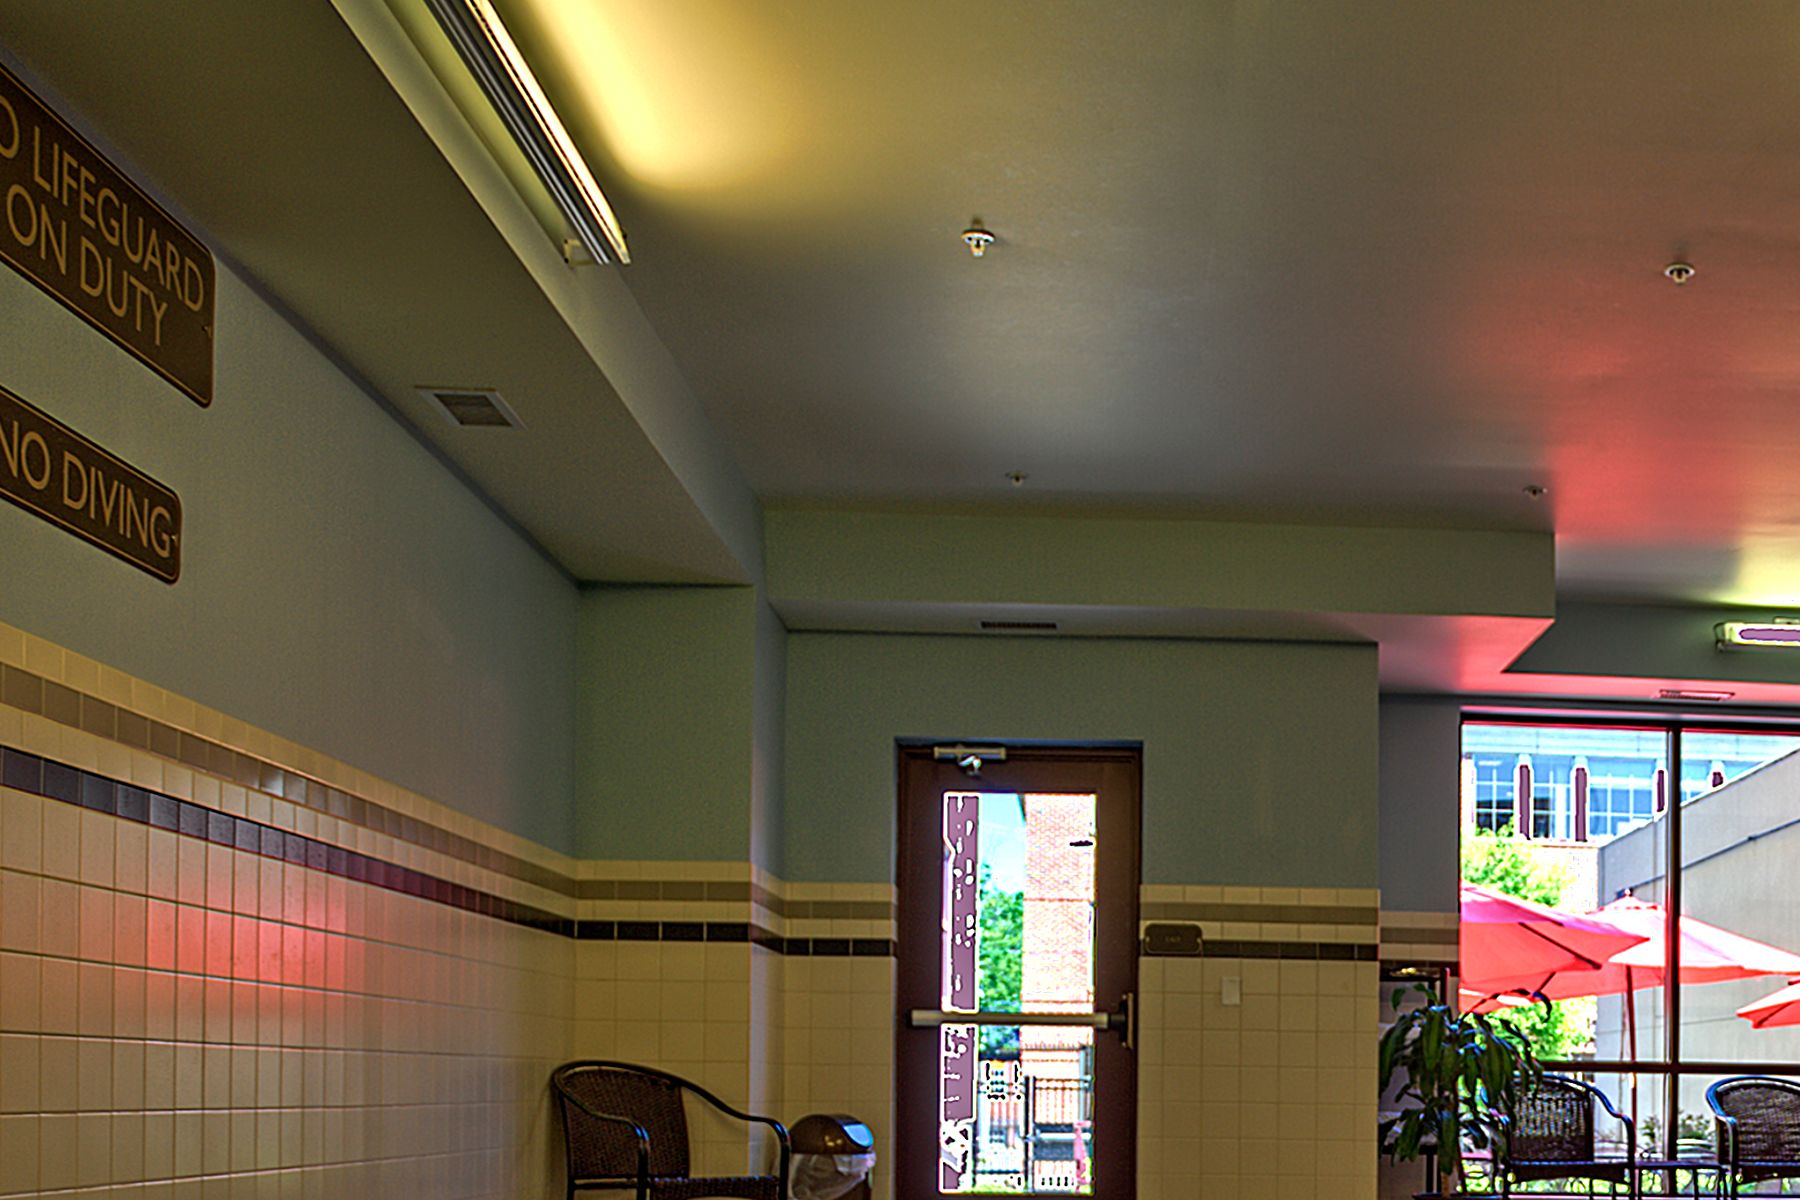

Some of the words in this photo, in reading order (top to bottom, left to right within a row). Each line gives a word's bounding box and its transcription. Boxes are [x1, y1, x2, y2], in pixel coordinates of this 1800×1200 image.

[6, 183, 67, 276] ON
[80, 235, 168, 346] DUTY
[34, 125, 205, 312] LIFEGUARD
[0, 419, 50, 490] NO
[63, 451, 173, 558] DIVING
